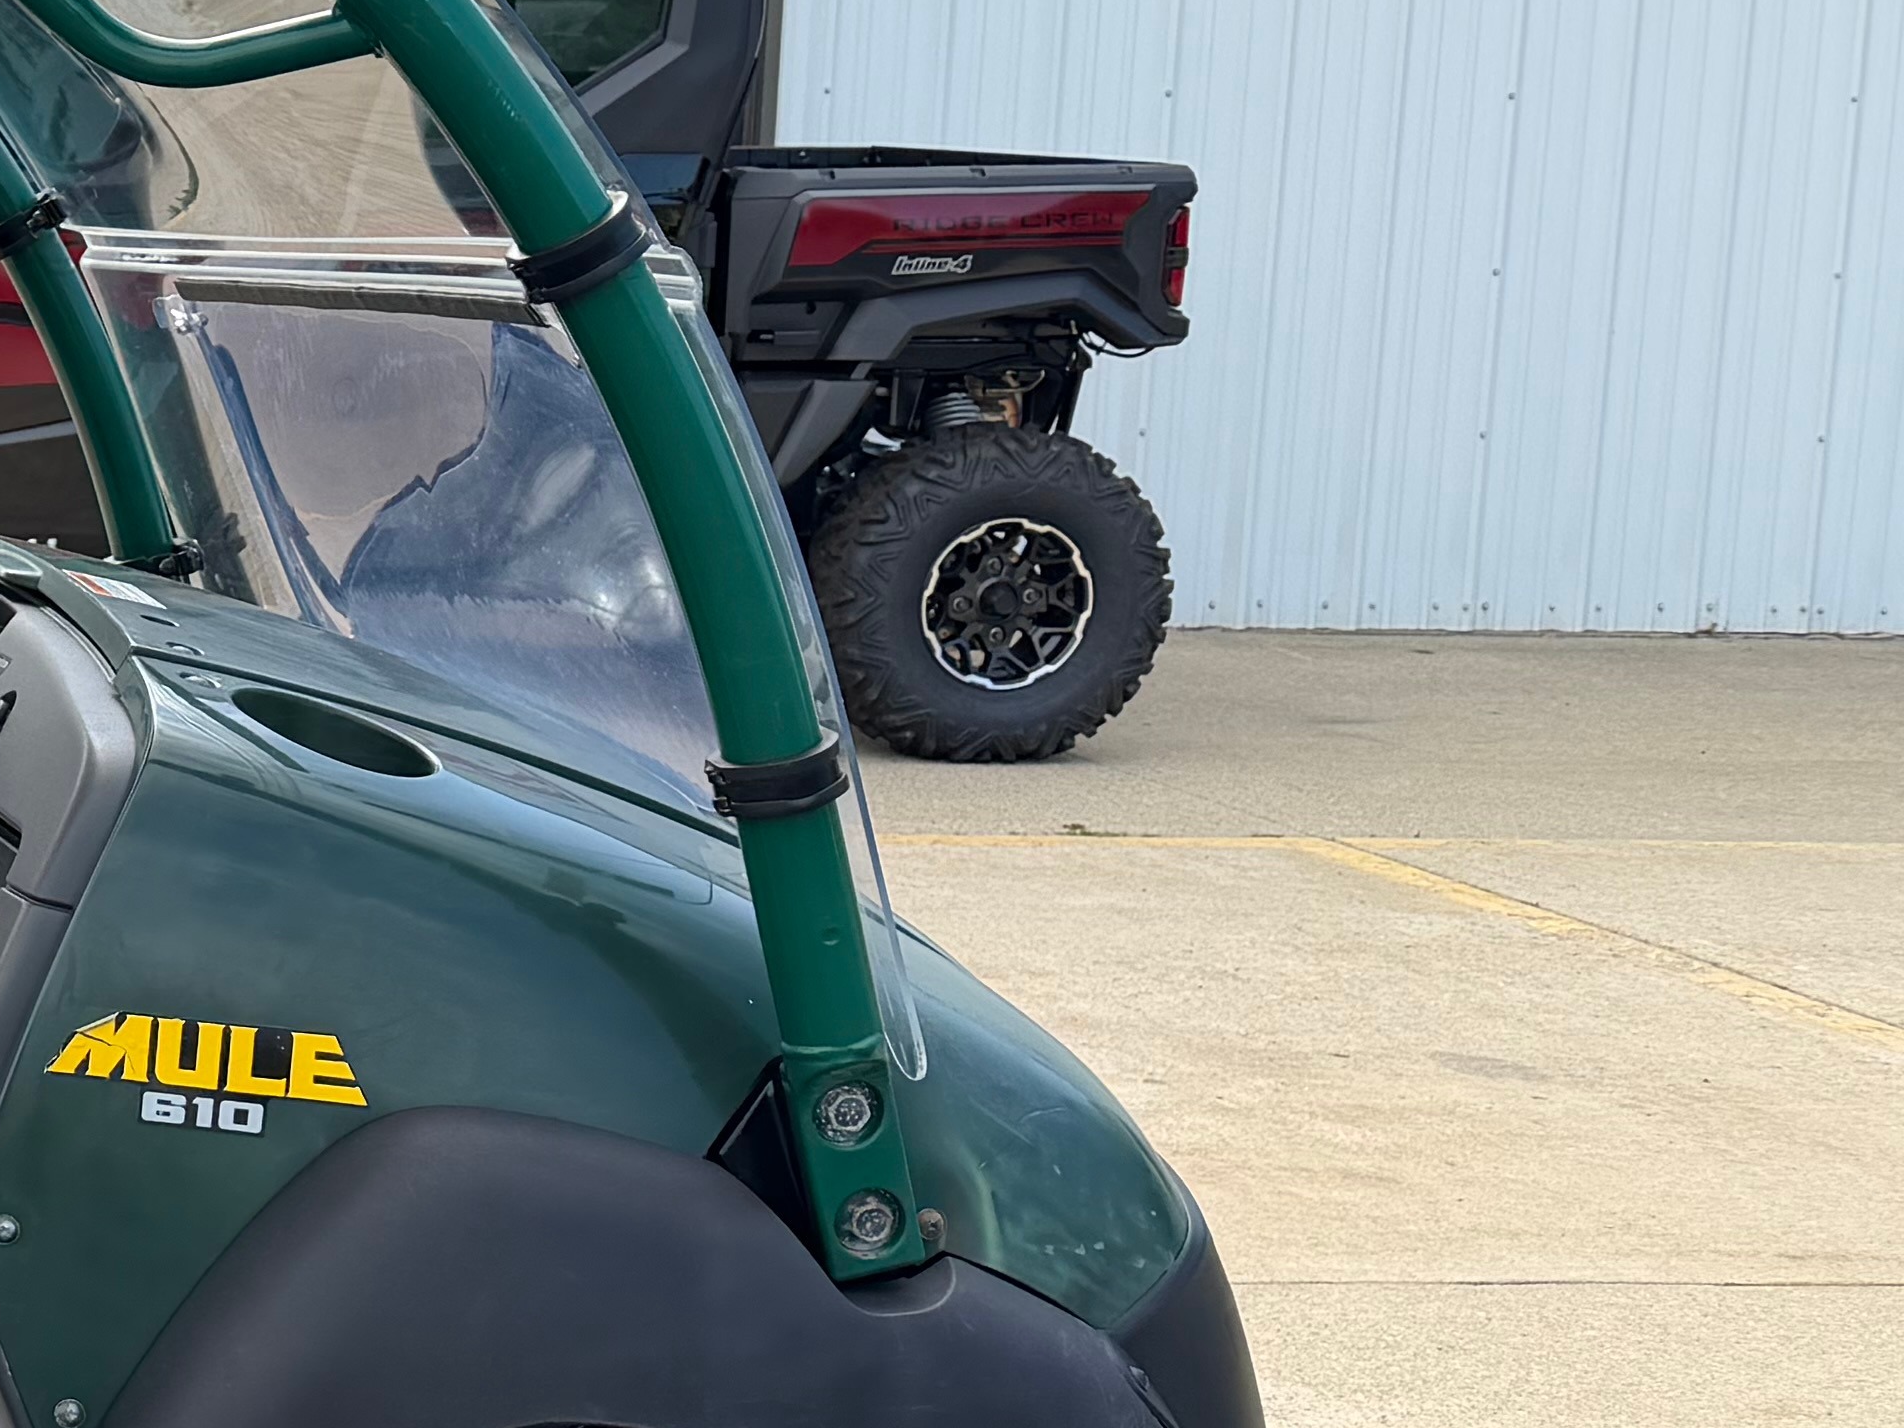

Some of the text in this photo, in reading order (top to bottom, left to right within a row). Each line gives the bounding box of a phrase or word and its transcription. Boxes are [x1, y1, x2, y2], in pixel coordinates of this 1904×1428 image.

[1021, 212, 1113, 228] CREW
[45, 1012, 369, 1106] MULE
[139, 1090, 266, 1135] 610
